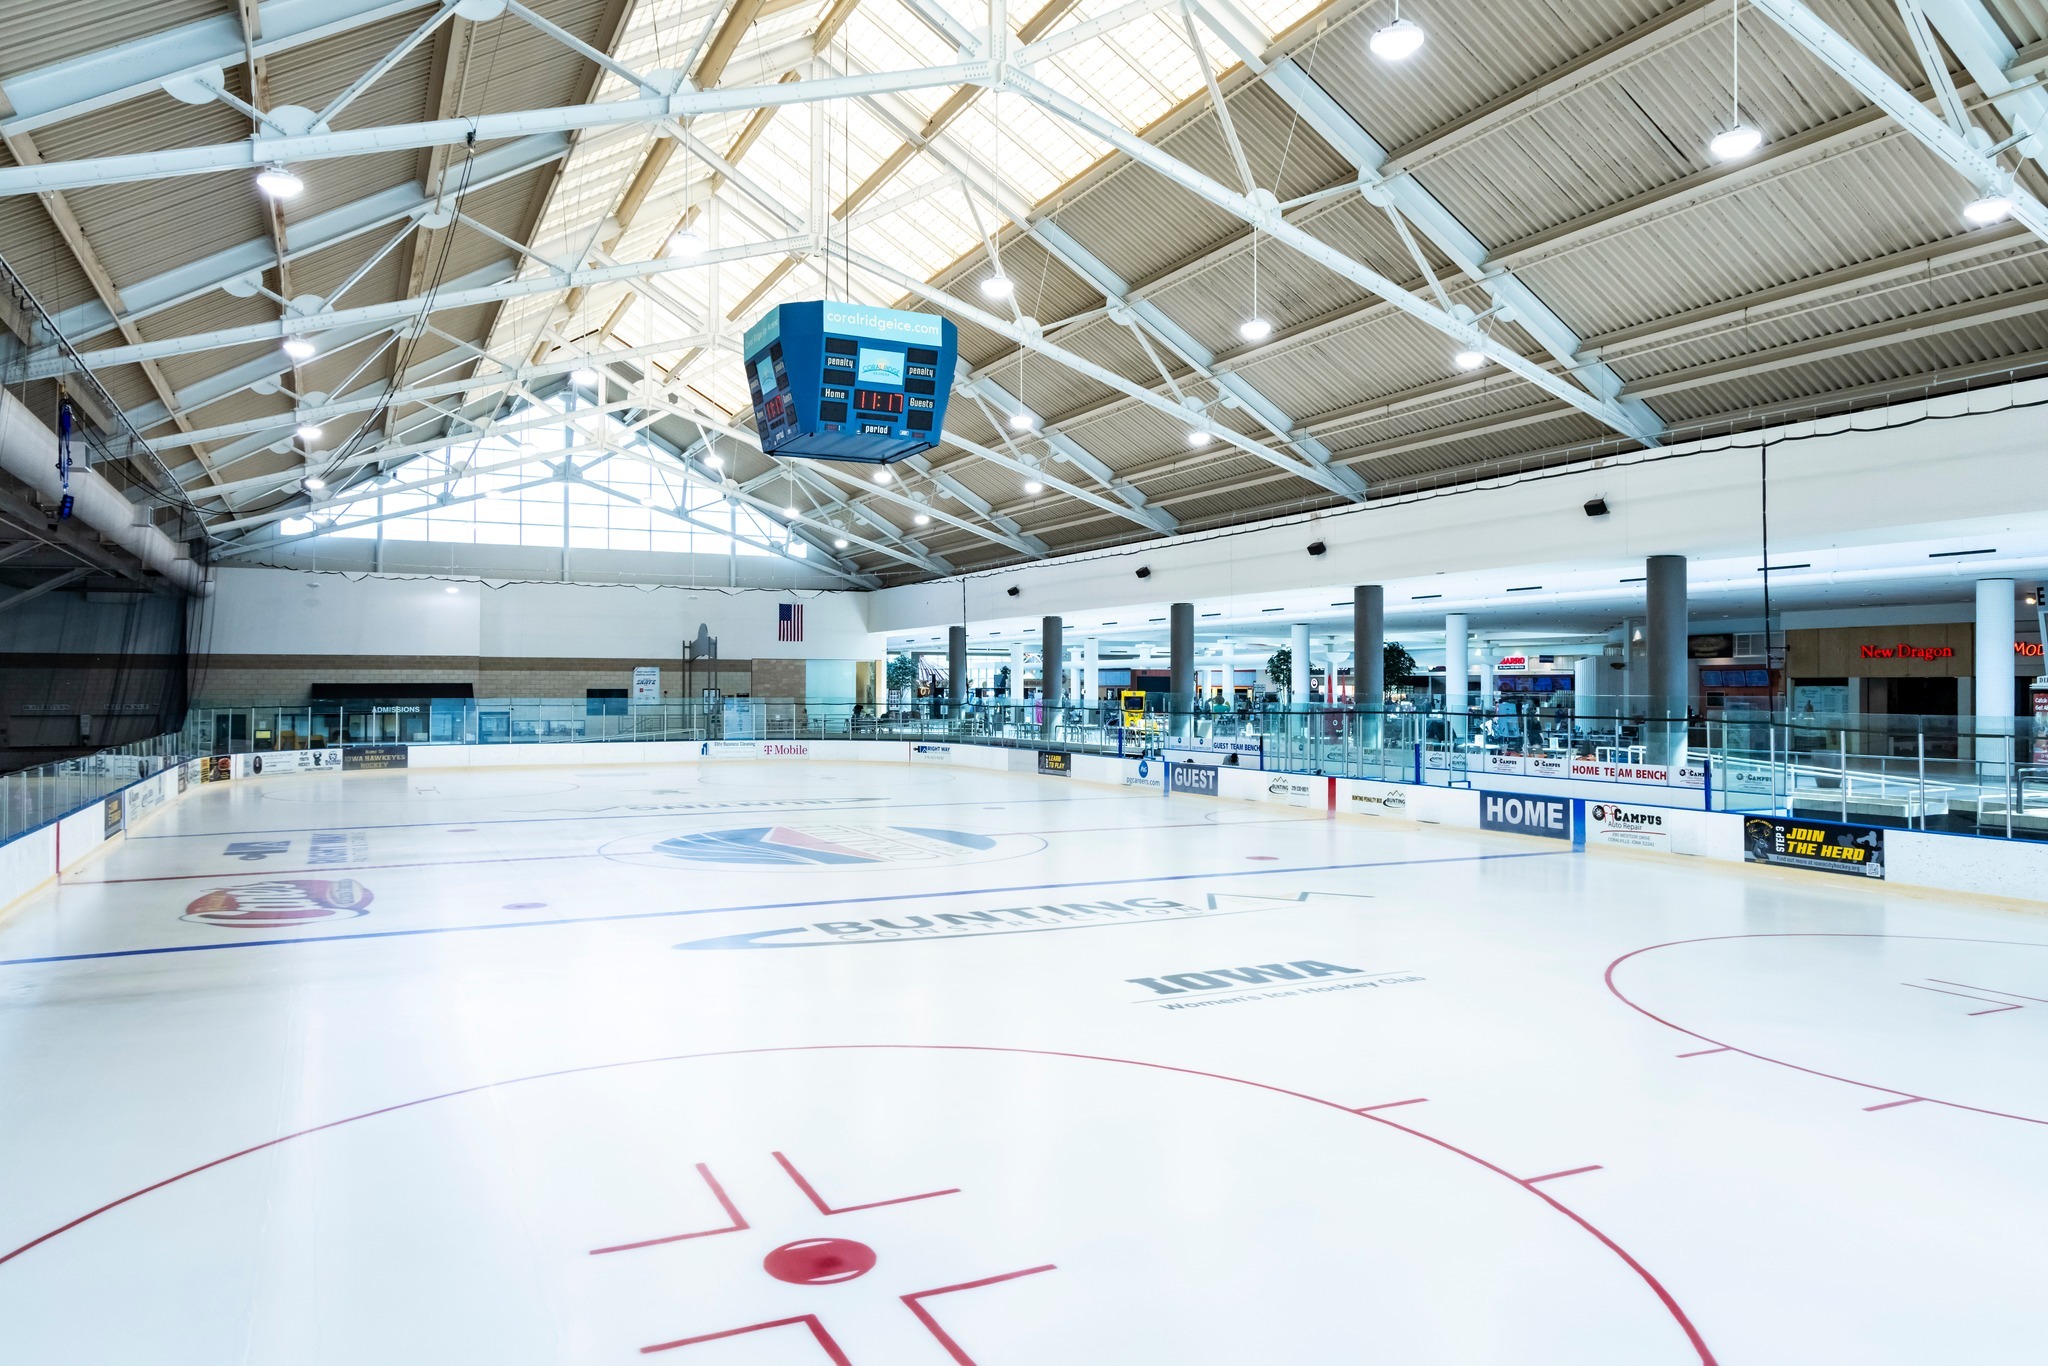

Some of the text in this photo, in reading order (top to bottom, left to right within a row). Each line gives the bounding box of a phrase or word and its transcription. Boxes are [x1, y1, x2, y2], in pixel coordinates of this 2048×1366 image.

[827, 313, 939, 334] coralridgeice.com
[827, 357, 854, 368] penalty
[909, 367, 934, 377] penalty
[825, 388, 845, 399] Home
[861, 391, 903, 412] 11:17
[910, 398, 934, 409] Guests
[865, 425, 888, 434] period
[1860, 643, 1953, 661] New Dragon
[774, 745, 808, 755] Mobile
[1213, 742, 1260, 752] GUEST TEAM BENCH
[1174, 767, 1215, 790] GUEST
[1572, 765, 1600, 776] HOME
[1635, 769, 1667, 781] BENCH
[1486, 796, 1563, 829] HOME
[1608, 821, 1643, 831] Auto Repair
[1786, 827, 1825, 843] JOIN
[1775, 832, 1785, 853] STEP
[1787, 841, 1865, 861] THE HERD
[811, 897, 1185, 935] BUNTING
[838, 905, 1203, 942] CONSTRUCTION
[1124, 959, 1366, 995] IOWA
[1158, 974, 1427, 1011] Women's Ice Hockey Club
